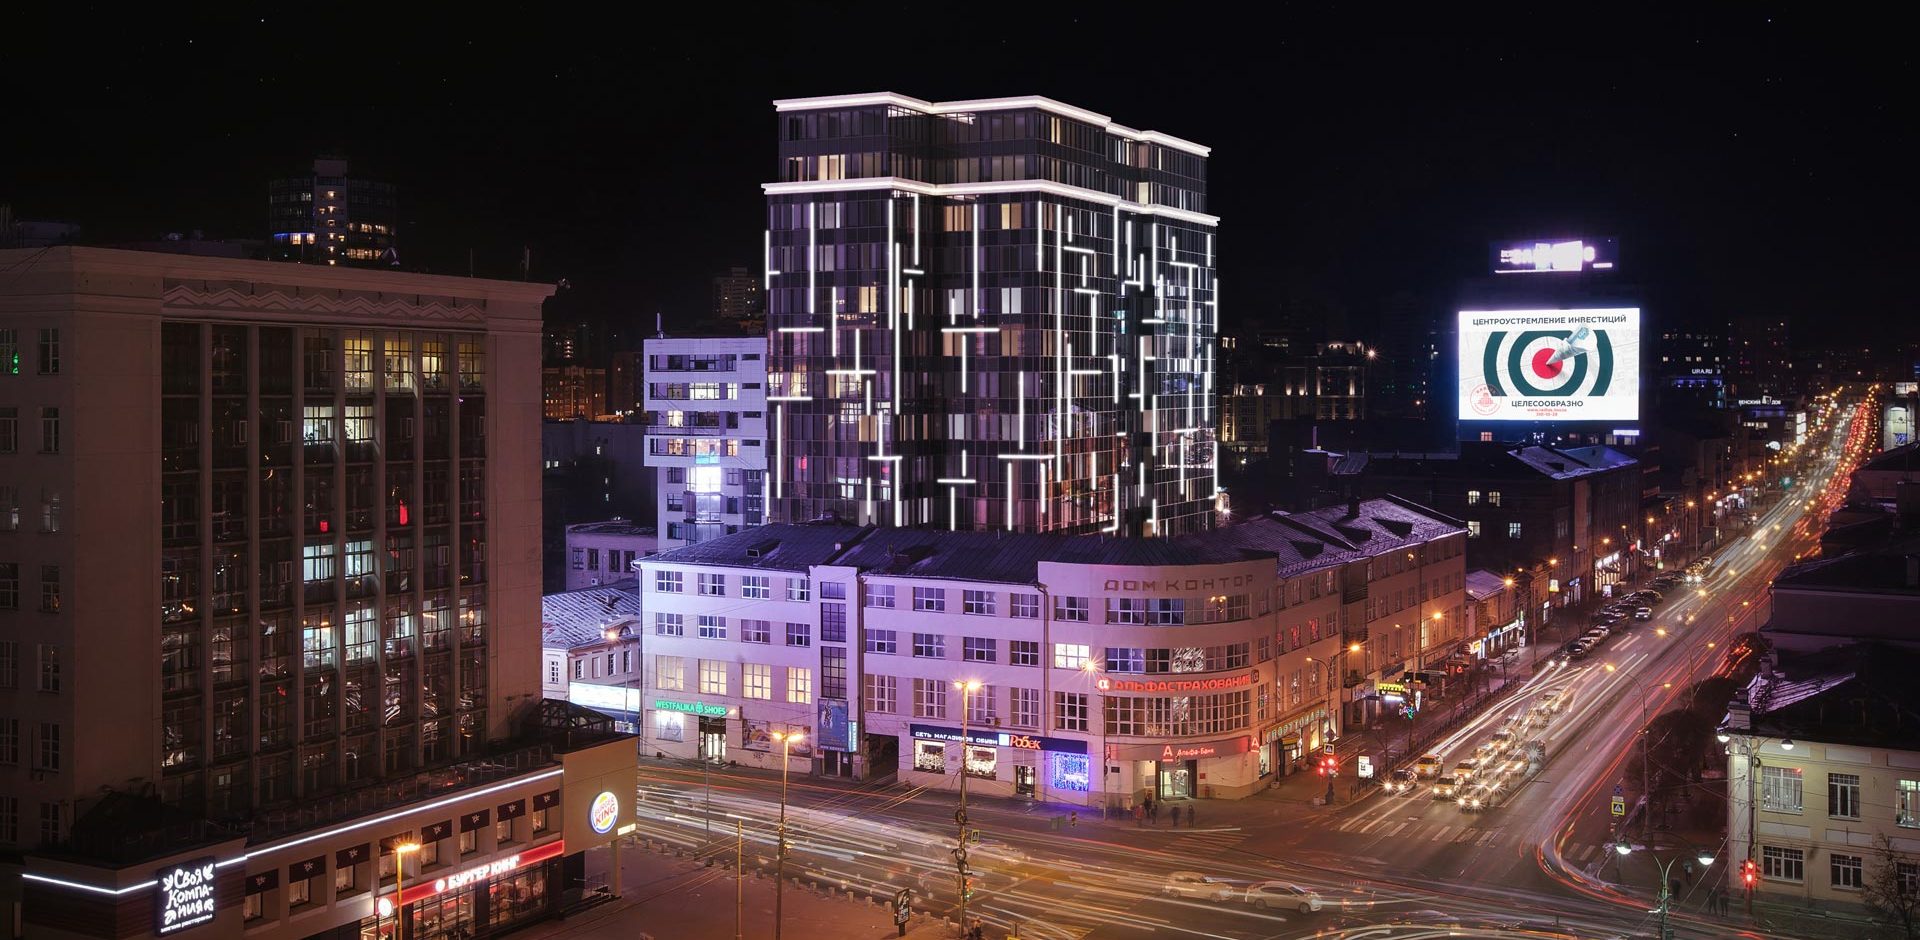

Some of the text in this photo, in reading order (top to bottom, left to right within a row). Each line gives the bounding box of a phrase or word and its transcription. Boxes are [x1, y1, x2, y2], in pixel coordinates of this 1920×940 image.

[1473, 314, 1627, 326] ЦЕНТРОУСТРЕМЛЕНИЕ ИНВЕСТИЦИЙ
[1103, 574, 1254, 592] ДОМ КОНТОР
[1114, 673, 1251, 692] АЛЬФАСТРАХОВАНИЕ
[655, 699, 726, 715] WESTFALIKA SHOES
[934, 733, 974, 743] МАГАЗИНОВ
[1009, 734, 1041, 749] Робек
[1176, 747, 1215, 757] Альфа-Банк
[596, 803, 616, 826] KING
[174, 868, 203, 889] Своя
[448, 855, 517, 890] БУРГЕР КИНГ
